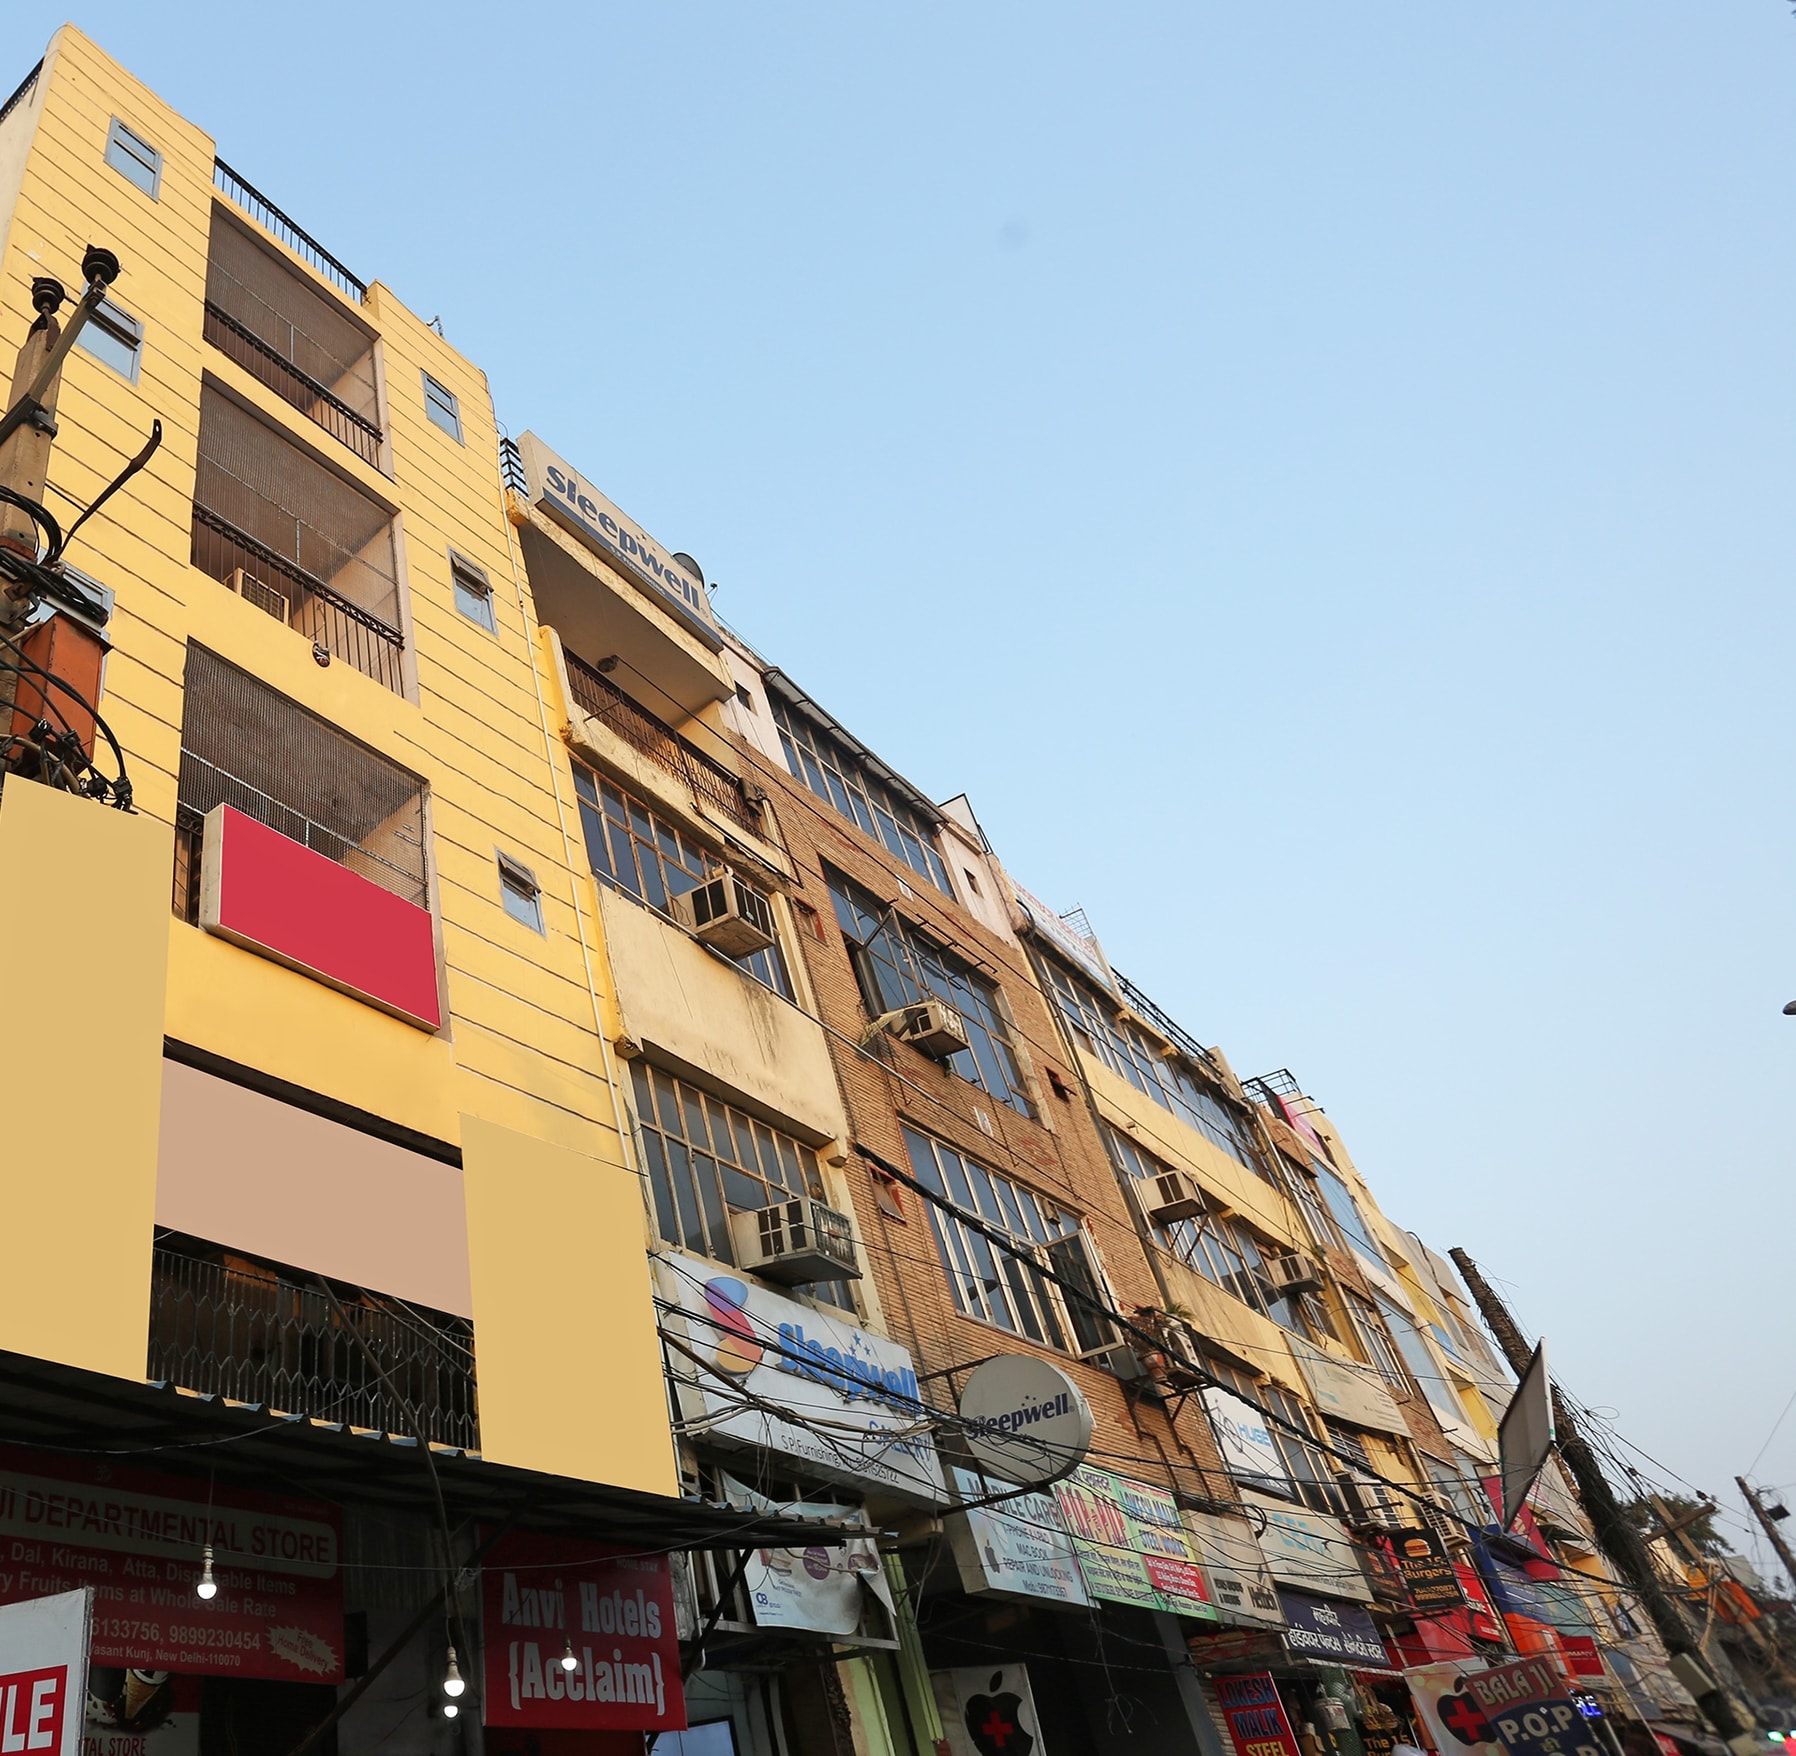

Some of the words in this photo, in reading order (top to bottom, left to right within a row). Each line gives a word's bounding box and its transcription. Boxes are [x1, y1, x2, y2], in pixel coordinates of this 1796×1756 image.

[546, 465, 700, 611] Sleepwell
[777, 1322, 921, 1416] Sleepwell
[25, 1490, 243, 1553] DEPARTMENTAL
[251, 1526, 329, 1562] STORE
[52, 1547, 113, 1576] Kirana,
[122, 1557, 161, 1581] Atta,
[166, 1562, 252, 1592] Dispsable
[256, 1572, 296, 1596] Items
[1403, 1568, 1453, 1580] Burgers
[19, 1571, 72, 1594] Fruits
[129, 1587, 146, 1605] at
[243, 1597, 277, 1617] Rate
[502, 1572, 564, 1629] Anvi
[580, 1581, 661, 1639] Hotels
[155, 1649, 177, 1662] New
[180, 1650, 240, 1667] Delhi-110070
[169, 1624, 261, 1650] 9899230454
[1216, 1677, 1277, 1709] LOKESH
[1472, 1669, 1534, 1705] BALA
[1528, 1663, 1555, 1697] JI
[0, 1678, 57, 1754] LE
[1231, 1708, 1285, 1740] MALIK
[109, 1738, 147, 1756] STORE
[1363, 1737, 1390, 1750] The
